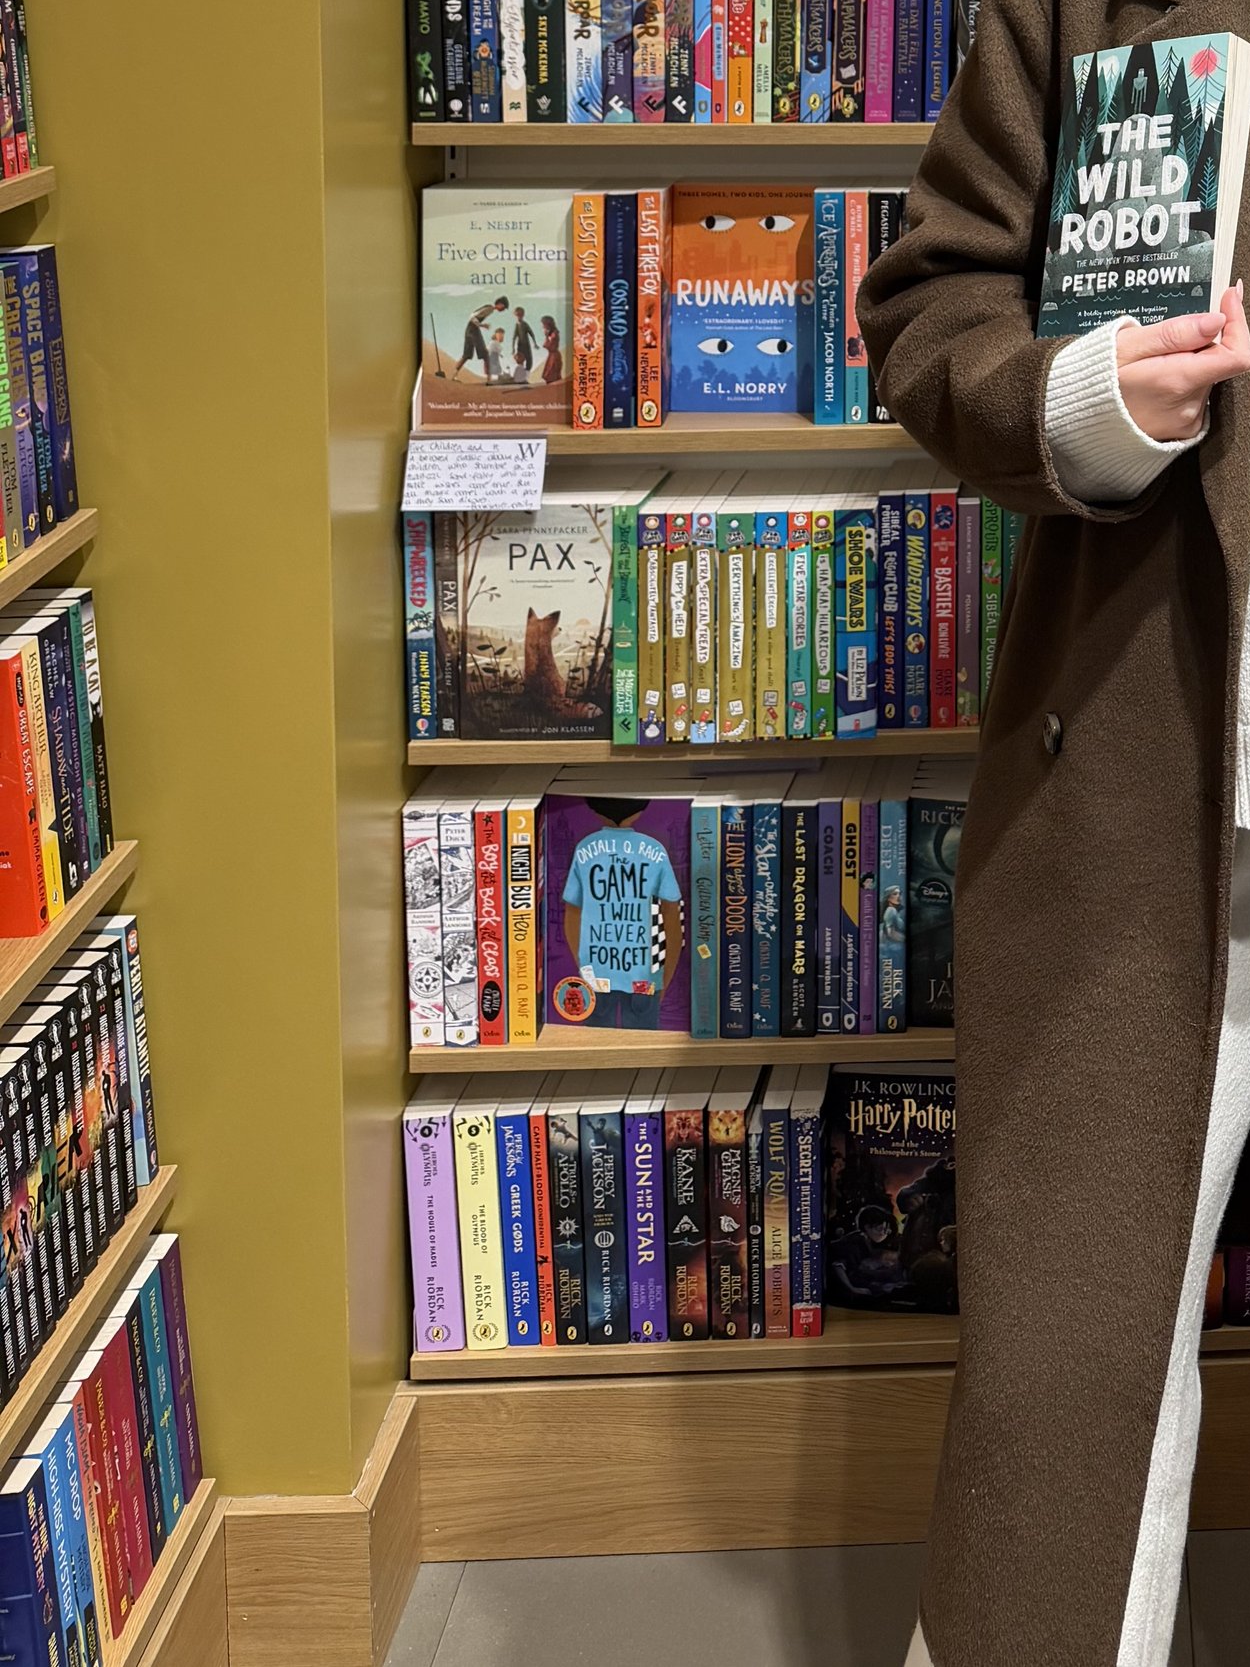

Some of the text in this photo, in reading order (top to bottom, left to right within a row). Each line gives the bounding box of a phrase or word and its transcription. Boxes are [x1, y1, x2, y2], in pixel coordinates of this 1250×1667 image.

[1097, 113, 1172, 155] THE
[1077, 155, 1188, 205] WILD
[487, 221, 532, 231] NESBIT
[1059, 200, 1201, 256] ROBOT
[437, 242, 569, 262] Five Children
[1076, 252, 1178, 268] THE NEW YORK TIMES BESTSELLER
[470, 266, 530, 286] and It
[1061, 265, 1191, 292] PETER BROWN
[676, 278, 815, 307] RUNAWAYS
[703, 383, 787, 394] E.L. NORRY
[518, 443, 541, 458] W
[509, 542, 576, 571] PAX
[542, 725, 595, 734] JON KLASSEN
[577, 839, 667, 864] ONJALI Q. RAÚF
[608, 854, 630, 865] The
[845, 823, 857, 880] GHOST
[589, 863, 650, 903] GAME
[600, 903, 643, 922] I WILL
[589, 924, 646, 944] NEVER
[589, 945, 649, 972] FORGET
[128, 954, 139, 1001] PERIL
[134, 1013, 150, 1083] ATLANTIC
[853, 1080, 875, 1094] J.K.
[846, 1100, 901, 1135] Harry
[634, 1143, 654, 1187] SUN
[510, 1184, 524, 1254] GREEK GODS
[635, 1209, 656, 1265] STAR
[64, 1430, 81, 1521] MIC DROP
